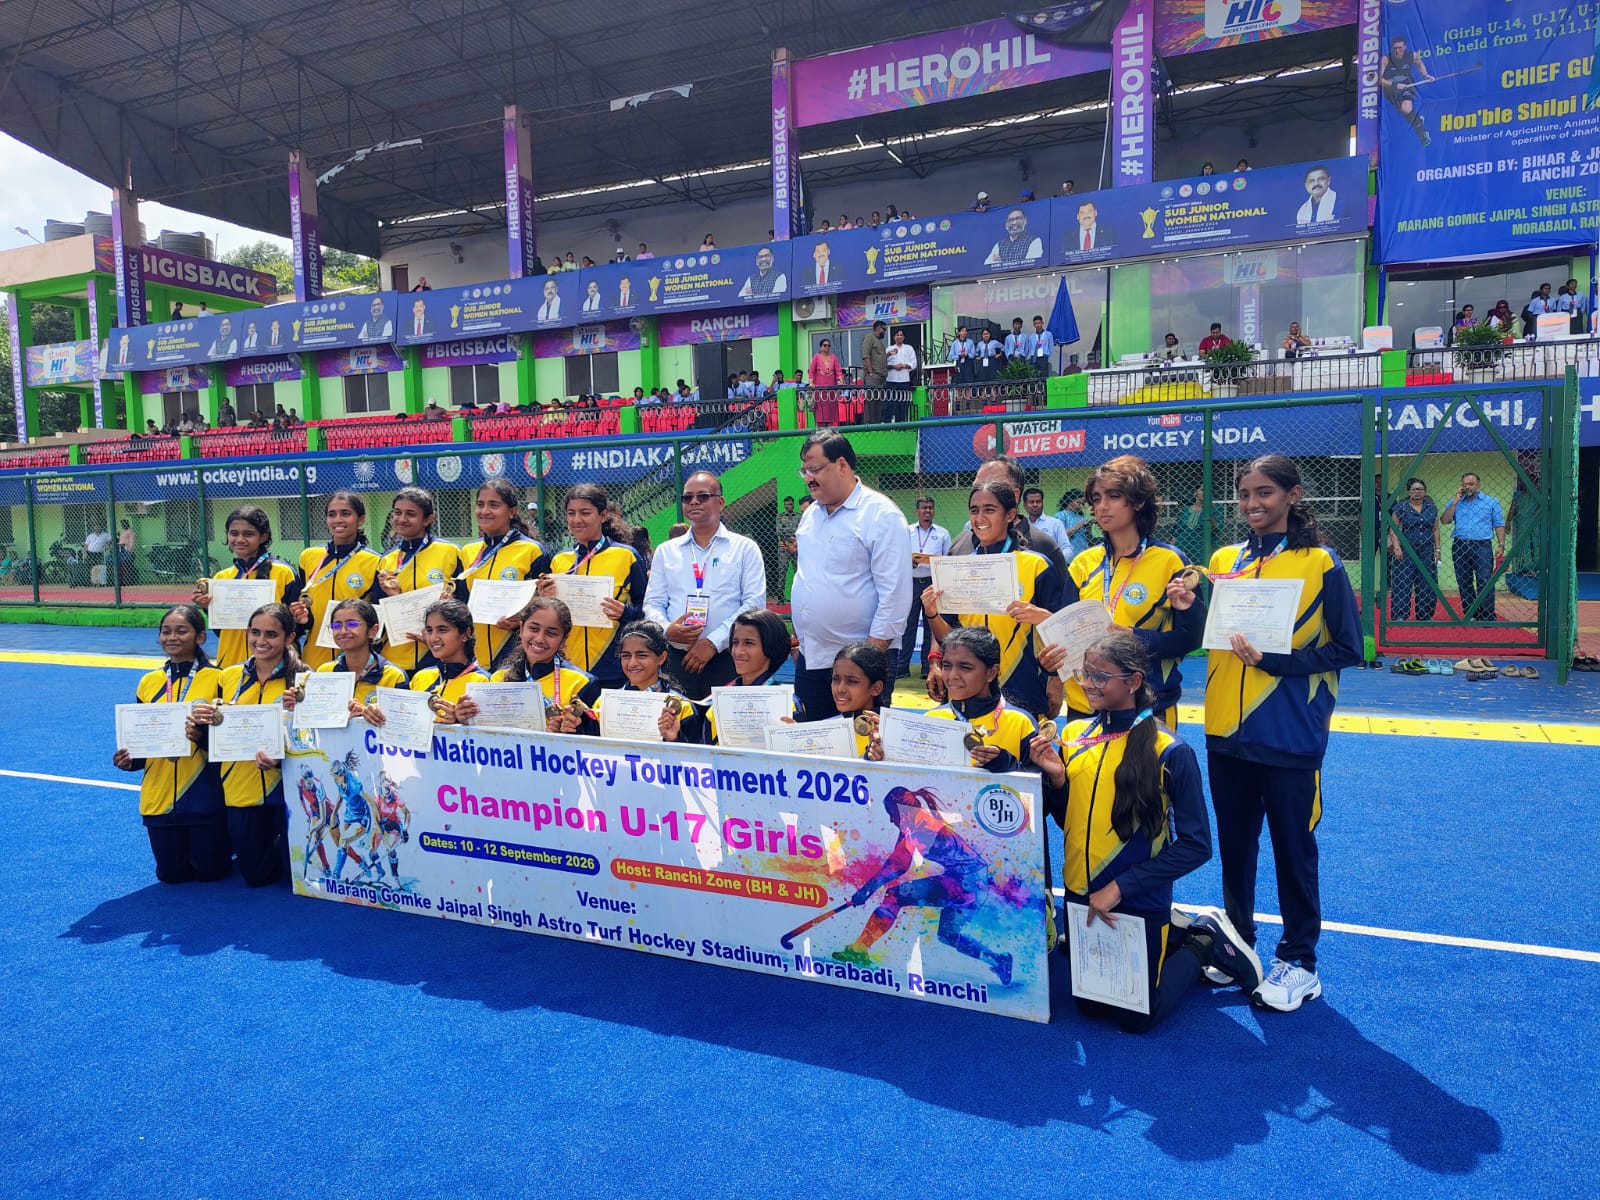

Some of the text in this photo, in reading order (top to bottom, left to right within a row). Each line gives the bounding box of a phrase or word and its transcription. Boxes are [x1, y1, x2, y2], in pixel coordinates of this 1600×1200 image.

[1444, 25, 1483, 43] (Girls
[1487, 17, 1526, 34] U-14,
[1532, 8, 1572, 27] U-17,
[1417, 49, 1431, 59] to
[1436, 44, 1452, 57] be
[1457, 37, 1488, 53] held
[1492, 33, 1528, 47] from
[847, 33, 1052, 101] #HEROHIL
[1501, 61, 1561, 89] CHIEF
[1120, 13, 1144, 176] #HEROHIL
[1440, 108, 1513, 132] Hon'ble
[1517, 95, 1577, 121] Shilpi
[1454, 115, 1600, 144] Minister of Agriculture, Animal
[1511, 132, 1557, 146] operative
[1559, 130, 1569, 140] of
[774, 105, 788, 209] #BIGISBACK
[1416, 162, 1493, 182] ORGANISED
[1497, 158, 1518, 173] BY:
[1522, 152, 1566, 169] BIHAR
[1570, 150, 1581, 163] &
[1522, 165, 1576, 183] RANCHI
[507, 164, 520, 240] #HEROHIL
[1545, 185, 1587, 201] VENUE:
[1164, 207, 1268, 226] WOMEN NATIONAL
[1165, 208, 1187, 217] SUB
[1188, 202, 1230, 214] JUNIOR
[1397, 216, 1444, 233] MARANG
[1447, 211, 1486, 227] GOMKE
[1489, 207, 1528, 223] JAIPAL
[1531, 203, 1567, 218] SINGH
[290, 194, 304, 277] #BIGISBACK
[1512, 219, 1577, 235] MORABADI,
[883, 246, 968, 264] WOMEN NATIONAL
[884, 247, 902, 256] SUB
[904, 241, 937, 252] JUNIOR
[114, 236, 125, 297] #HEROHIL
[308, 229, 318, 297] #HEROHIL
[127, 253, 138, 328] #BIGISBACK
[664, 273, 709, 285] SUB JUNIOR
[664, 278, 734, 292] WOMEN NATIONAL
[463, 307, 522, 321] WOMEN NATIONAL
[477, 302, 501, 312] JUNIOR
[691, 314, 750, 333] RANCHI
[427, 338, 517, 359] #BIGISBACK
[240, 361, 293, 377] #HEROHIL
[14, 376, 24, 424] LEAGUE
[1012, 421, 1057, 435] WATCH
[1184, 412, 1221, 423] Chael
[1013, 434, 1081, 454] LIVE ON
[1103, 429, 1194, 450] HOCKEY
[62, 483, 96, 491] NATIONAL
[156, 466, 317, 487] www.ockeyindia.og
[433, 736, 523, 770] National
[531, 745, 618, 786] Hockey
[624, 754, 788, 797] Tournament
[796, 768, 870, 806] 2026
[437, 784, 824, 860] Champion U-17 Girls
[423, 835, 458, 850] Dates:
[460, 840, 474, 853] 10
[483, 843, 498, 855] 12
[500, 845, 563, 867] September
[565, 854, 595, 871] 2026
[616, 860, 822, 907] Host: Ranchi Zone (BH & JH)
[576, 890, 637, 915] Venue:
[325, 878, 988, 1004] Marang Gomke Jaipal Singh Astro Turf Hockey Stadium, Morabadi, Ranchi
